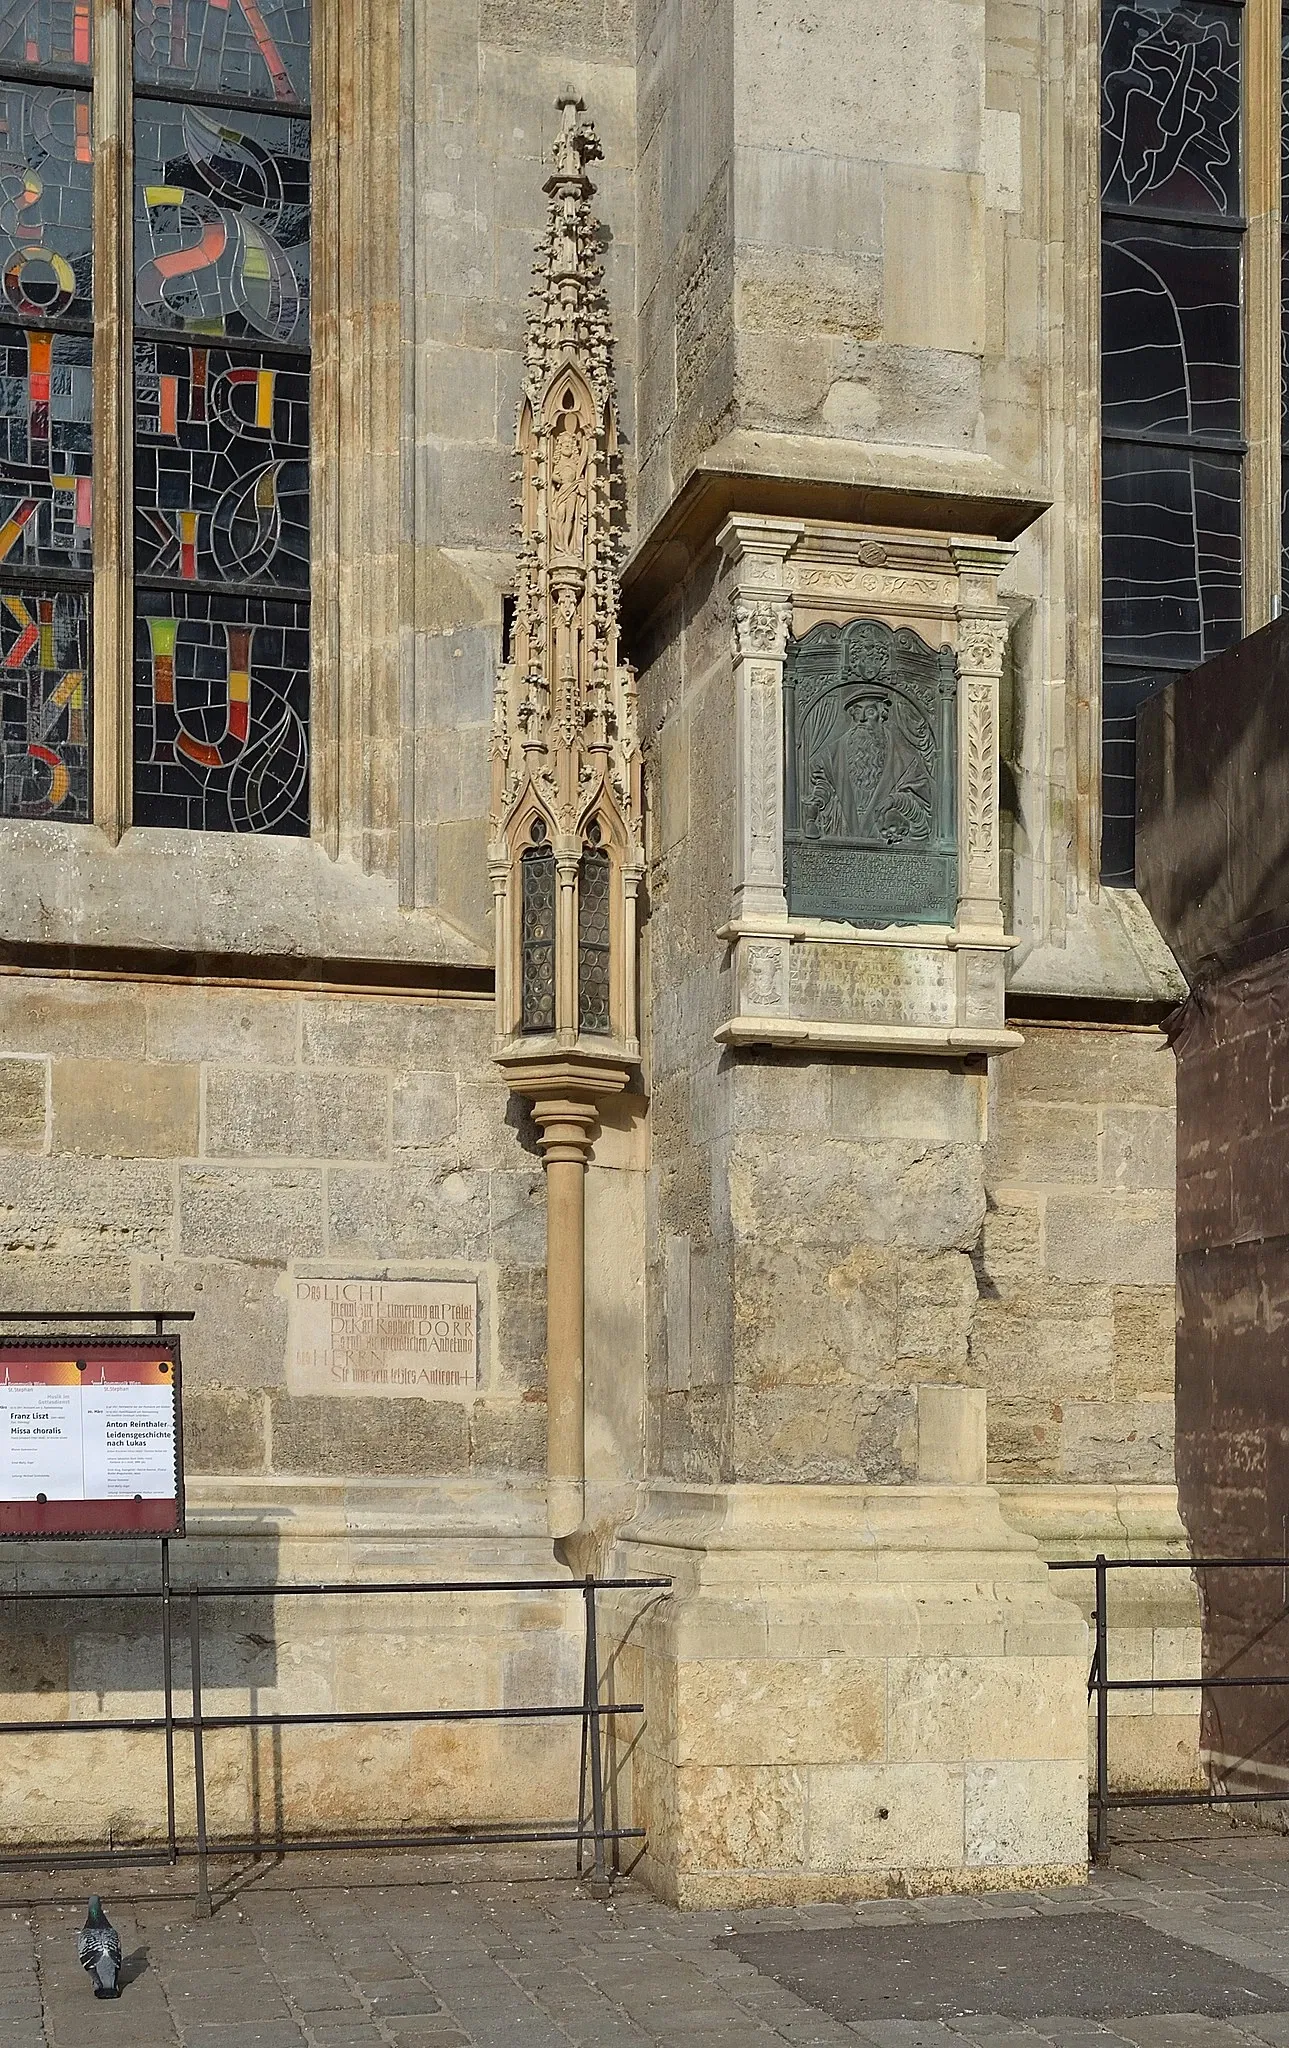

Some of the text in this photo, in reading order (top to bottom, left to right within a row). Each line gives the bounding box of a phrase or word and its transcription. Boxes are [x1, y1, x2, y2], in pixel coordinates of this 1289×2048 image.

[325, 1284, 388, 1301] LICHT
[430, 1304, 440, 1319] an
[419, 1321, 474, 1337] DORR
[10, 1412, 49, 1420] Franz Liszt
[130, 1420, 167, 1428] Reinthaler
[106, 1431, 171, 1440] Leidensgeschichte
